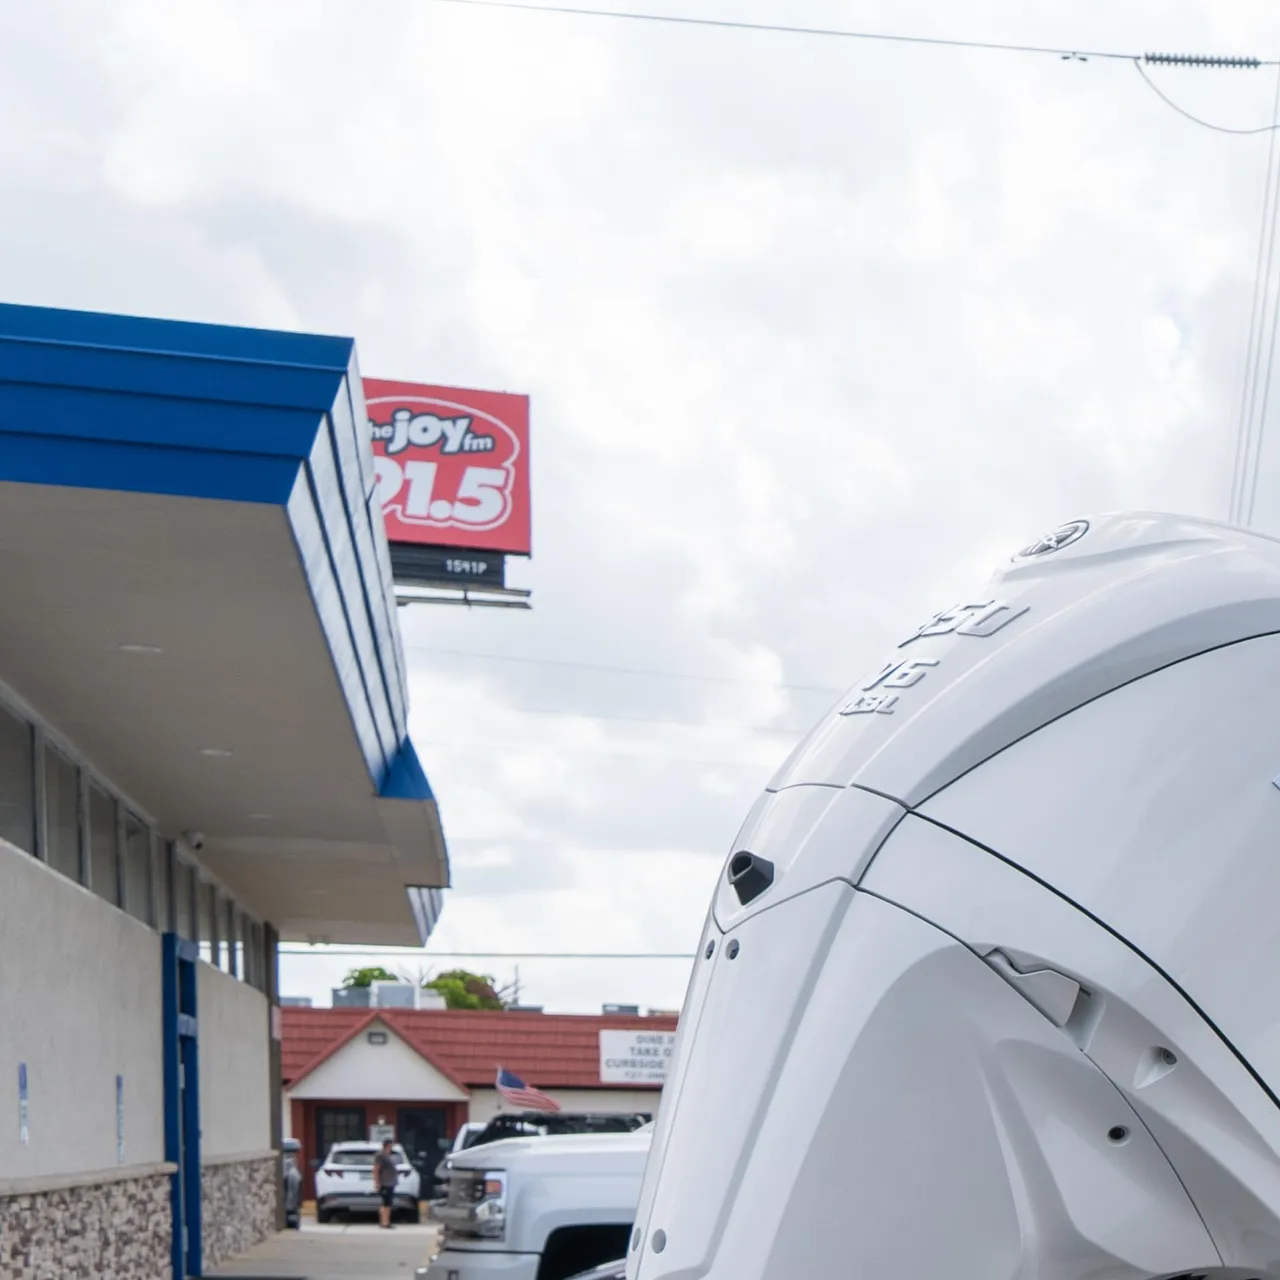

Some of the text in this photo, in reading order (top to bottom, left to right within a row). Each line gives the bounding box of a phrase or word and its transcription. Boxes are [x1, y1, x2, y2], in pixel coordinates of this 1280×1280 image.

[387, 410, 469, 453] joy
[463, 432, 494, 451] fm
[372, 455, 507, 523] 91.5
[629, 1046, 661, 1056] TAKE
